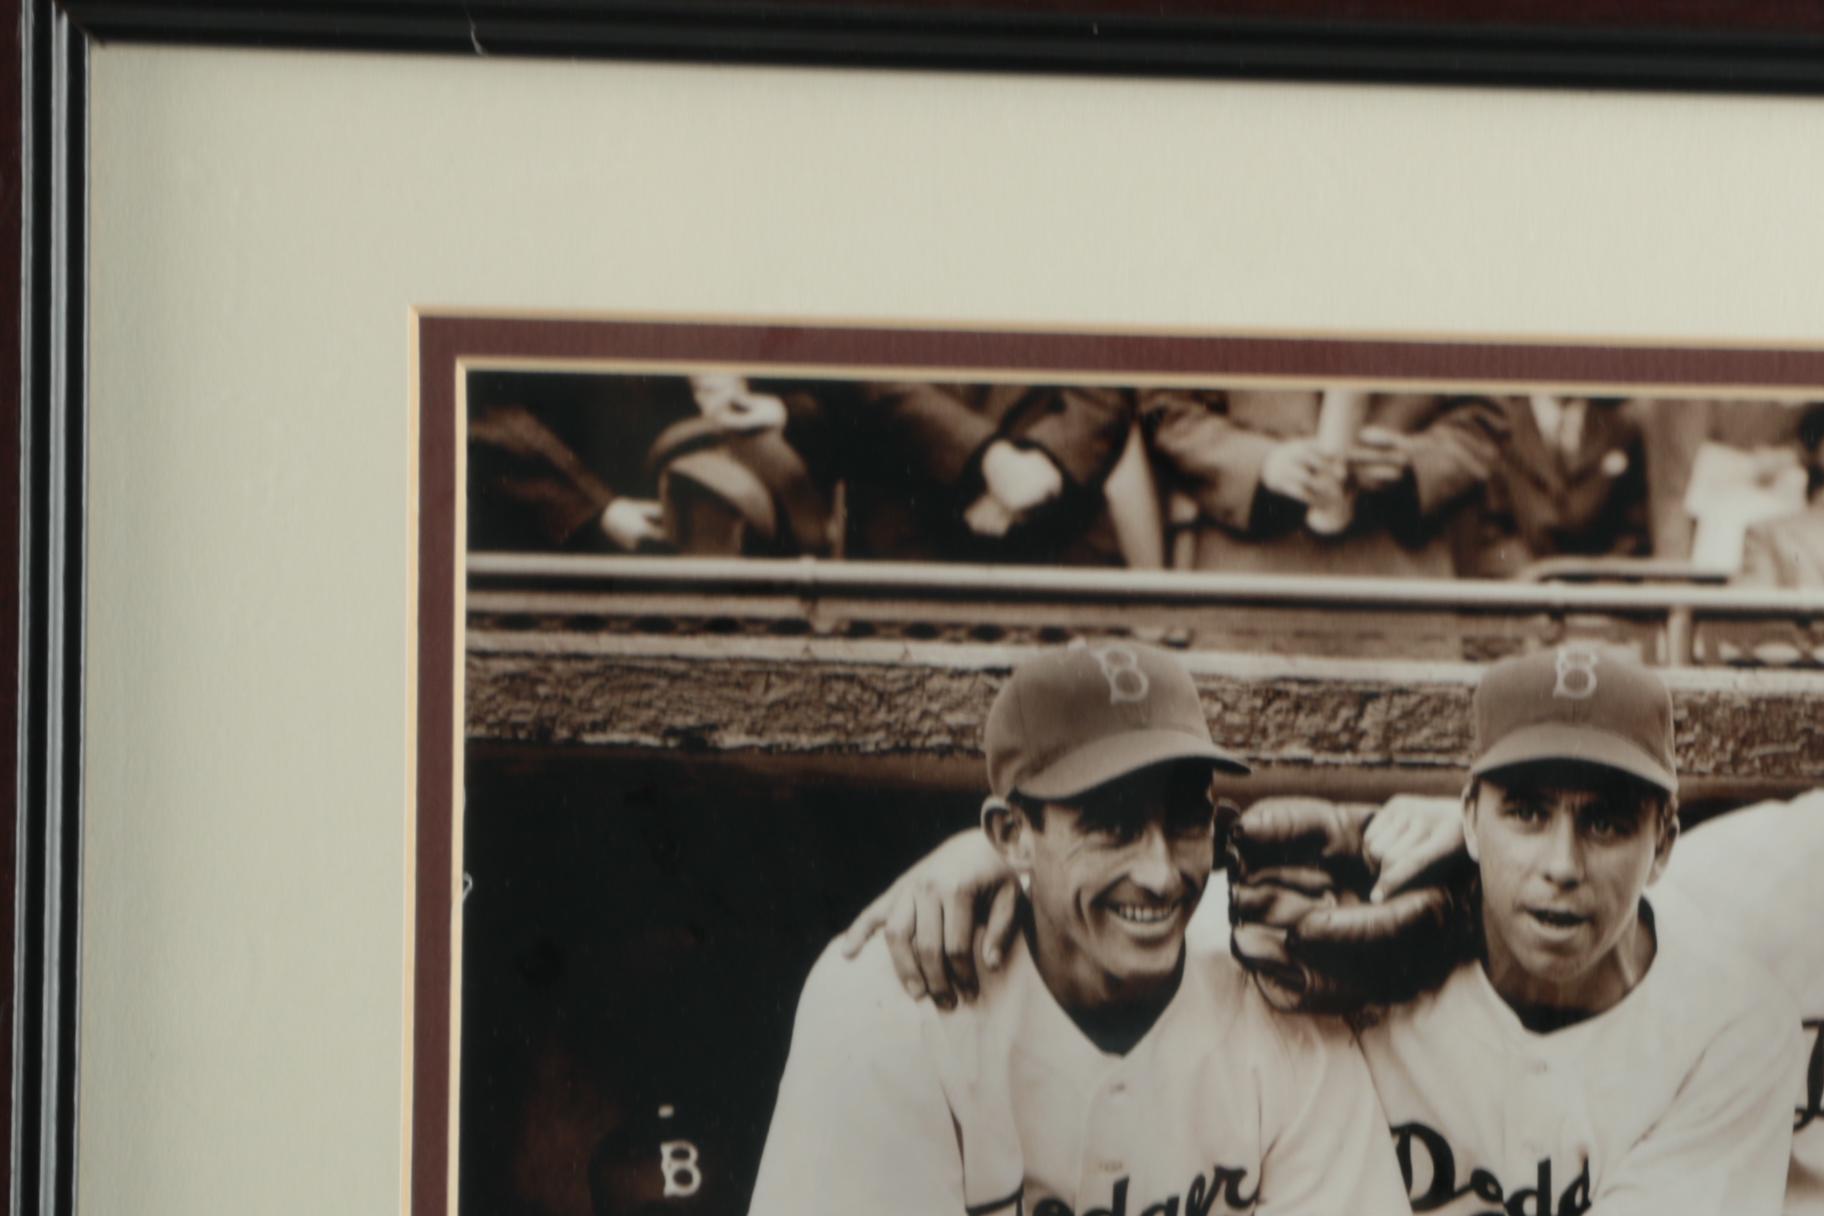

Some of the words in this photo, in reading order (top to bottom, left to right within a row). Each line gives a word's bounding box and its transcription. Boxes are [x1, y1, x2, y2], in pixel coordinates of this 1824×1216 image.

[1099, 644, 1149, 704] B
[1552, 641, 1598, 698] B
[660, 1140, 702, 1197] B
